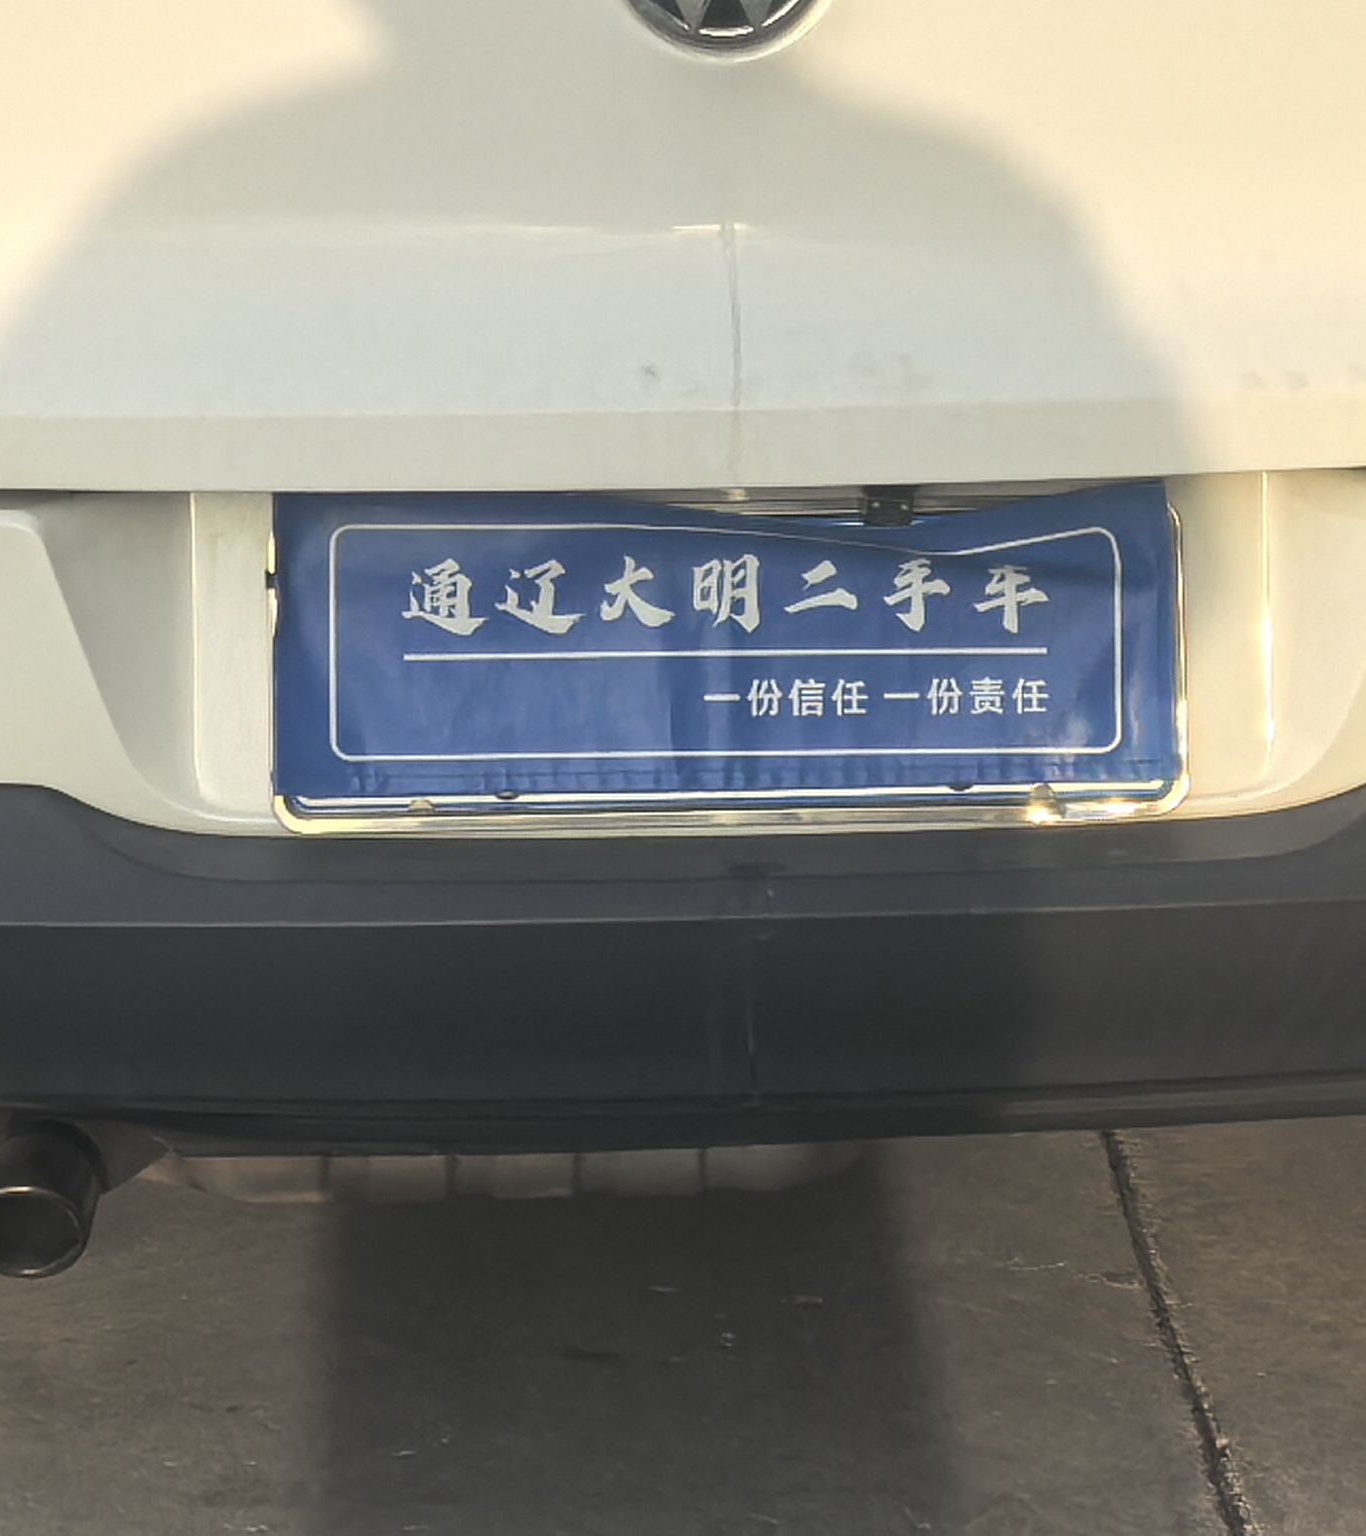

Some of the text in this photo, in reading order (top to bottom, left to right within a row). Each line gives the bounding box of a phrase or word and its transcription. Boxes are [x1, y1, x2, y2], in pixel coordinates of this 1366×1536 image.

[703, 676, 1051, 718] 一份信任 一份责任
